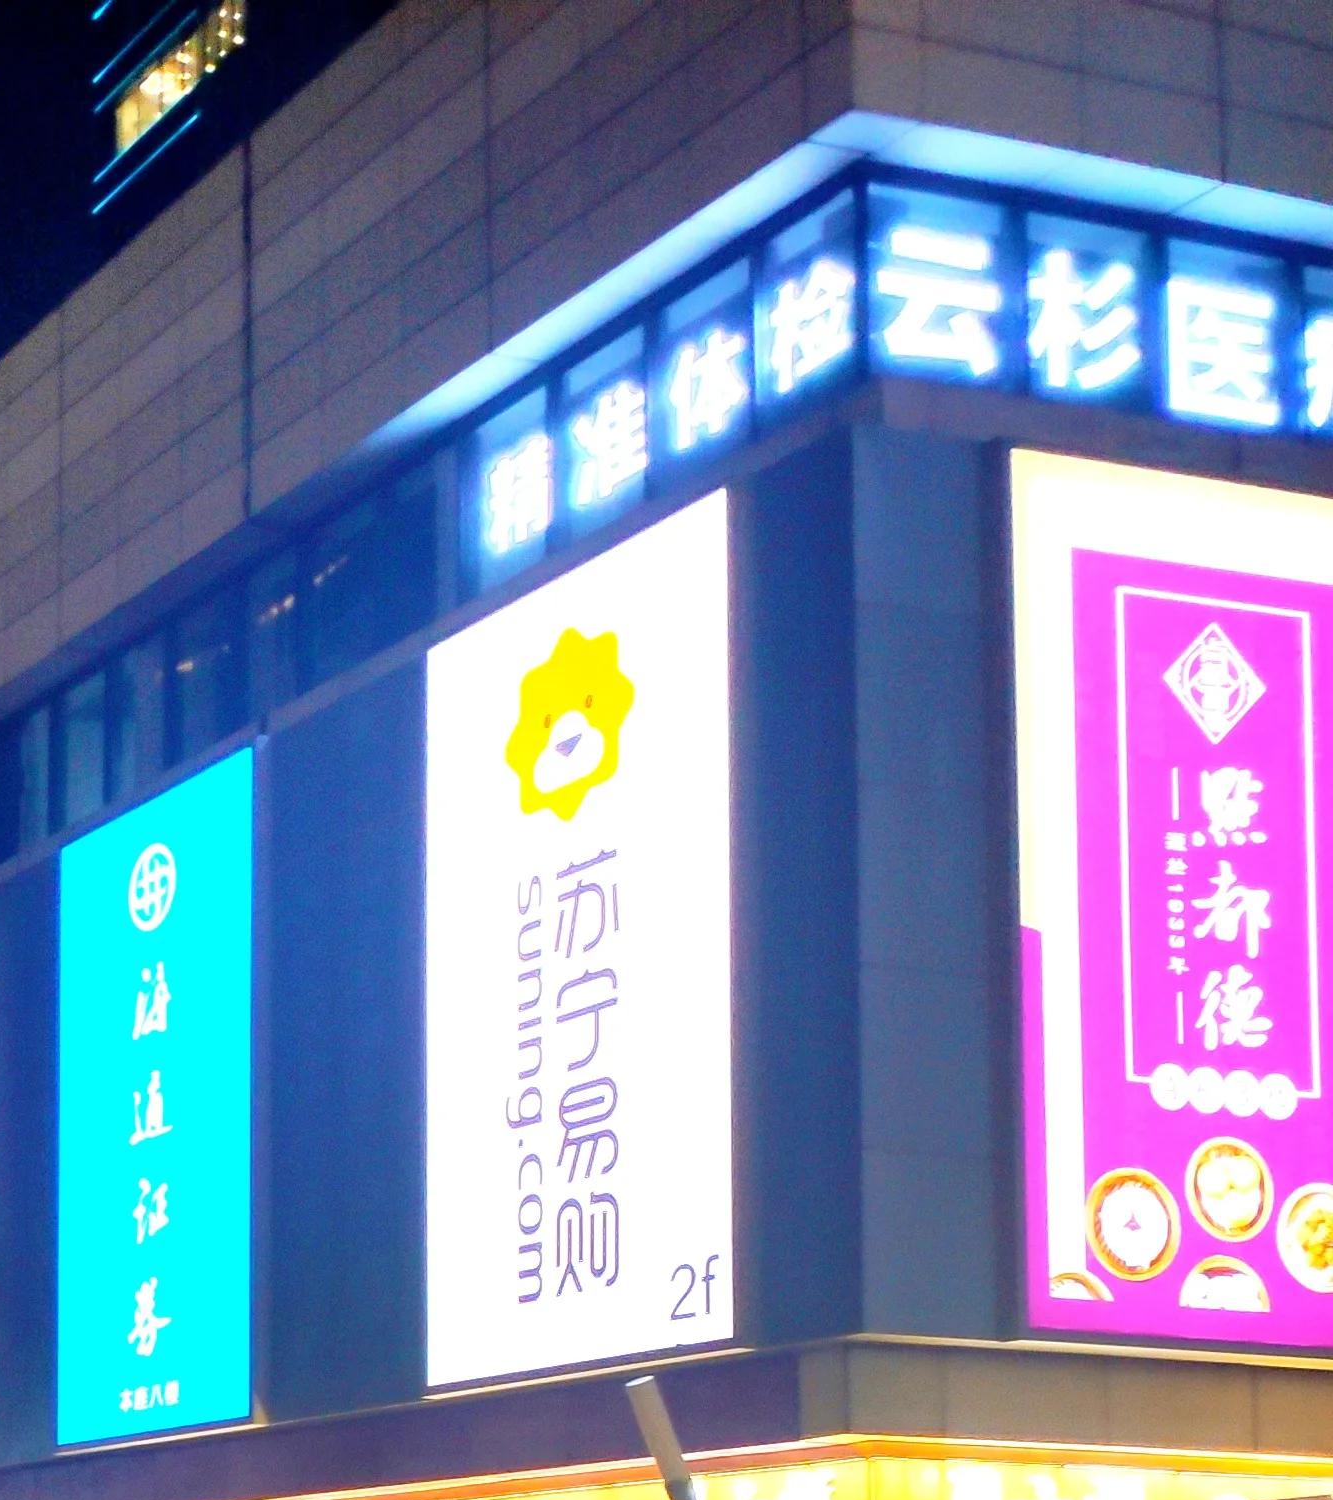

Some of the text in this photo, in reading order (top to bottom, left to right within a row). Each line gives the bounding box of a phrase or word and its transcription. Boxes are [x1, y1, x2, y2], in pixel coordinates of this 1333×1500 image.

[485, 258, 856, 554] 精准体检
[505, 873, 544, 1306] suning.com
[554, 848, 622, 1298] 苏宁易购
